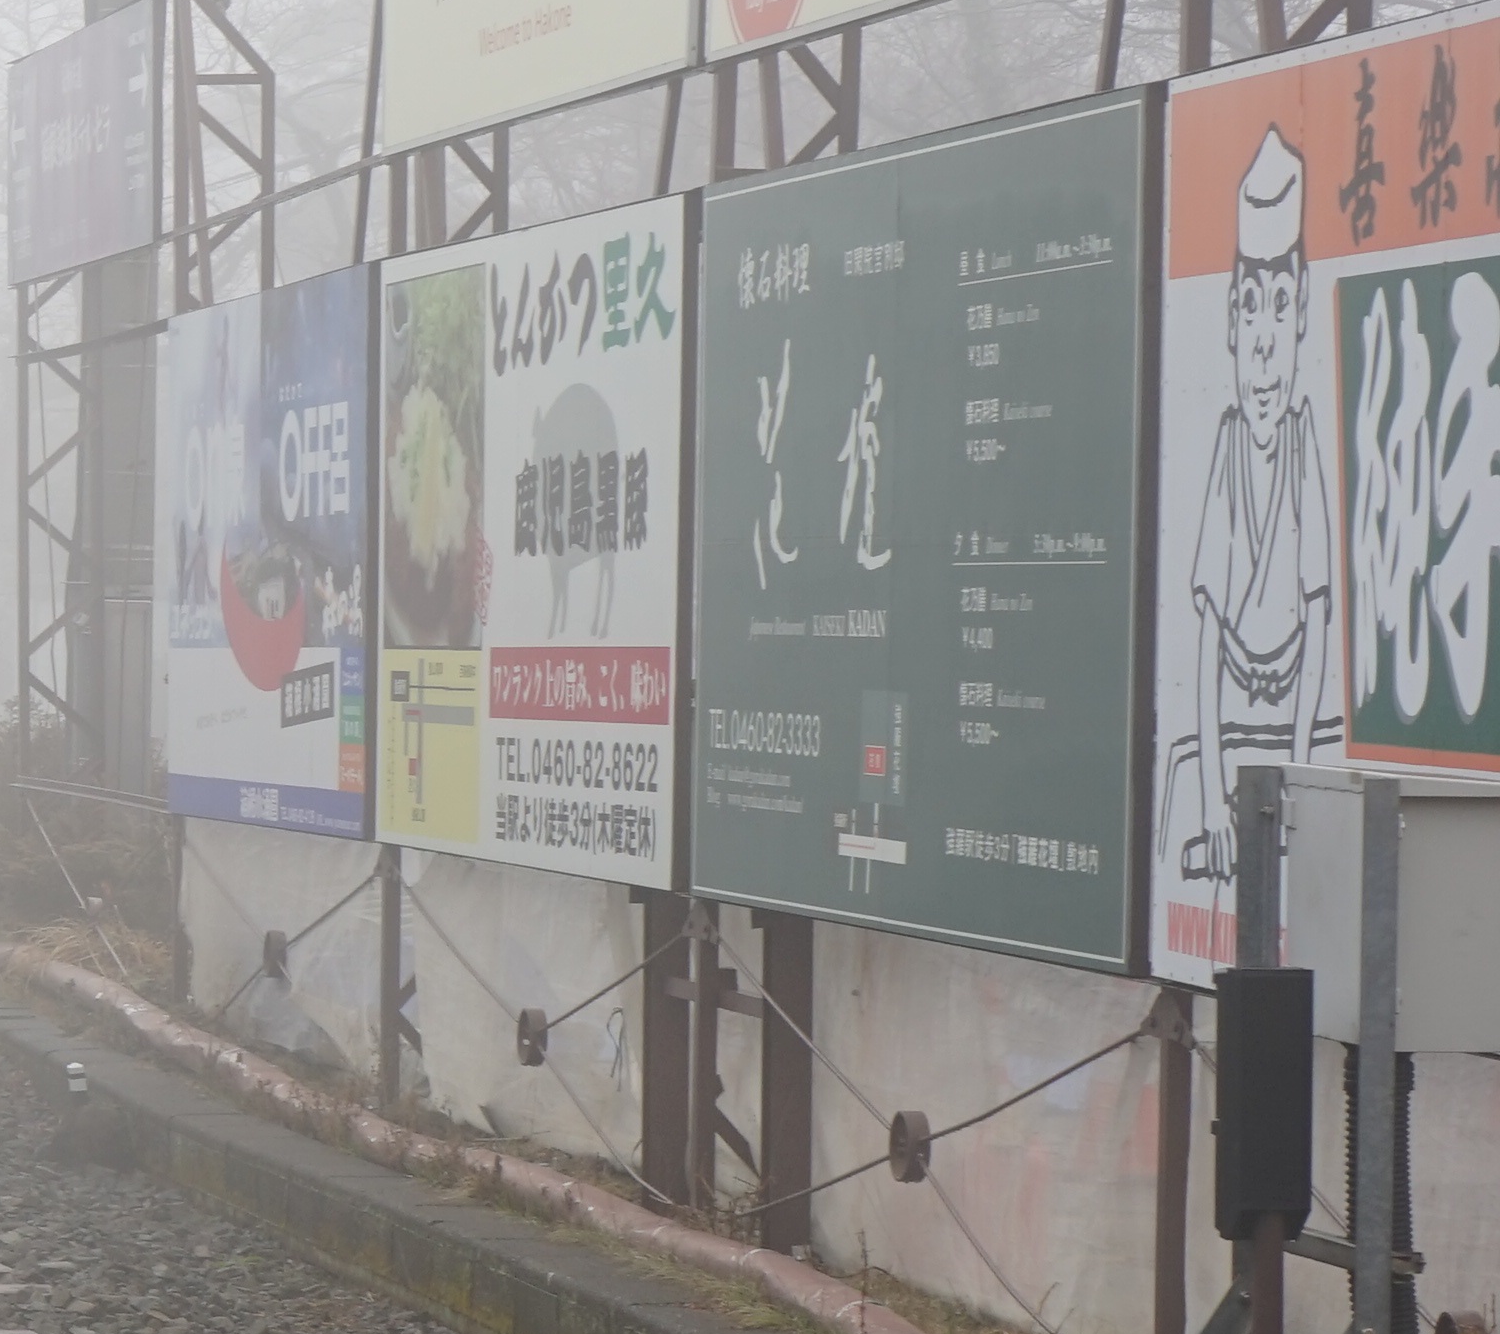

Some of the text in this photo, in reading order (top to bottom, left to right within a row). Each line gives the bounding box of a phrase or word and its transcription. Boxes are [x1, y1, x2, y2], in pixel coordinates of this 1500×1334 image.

[478, 4, 572, 56] Welcome to Hakone
[492, 231, 675, 376] とんかつ里久
[738, 243, 810, 309] 懐石料理
[279, 401, 349, 522] OFF呂
[514, 447, 648, 557] 鹿児島黒豚
[847, 609, 887, 637] KADAN
[496, 737, 658, 792] TEL.0460-82-8622
[495, 793, 656, 862] 当駅より徒歩3分(木曜定休)
